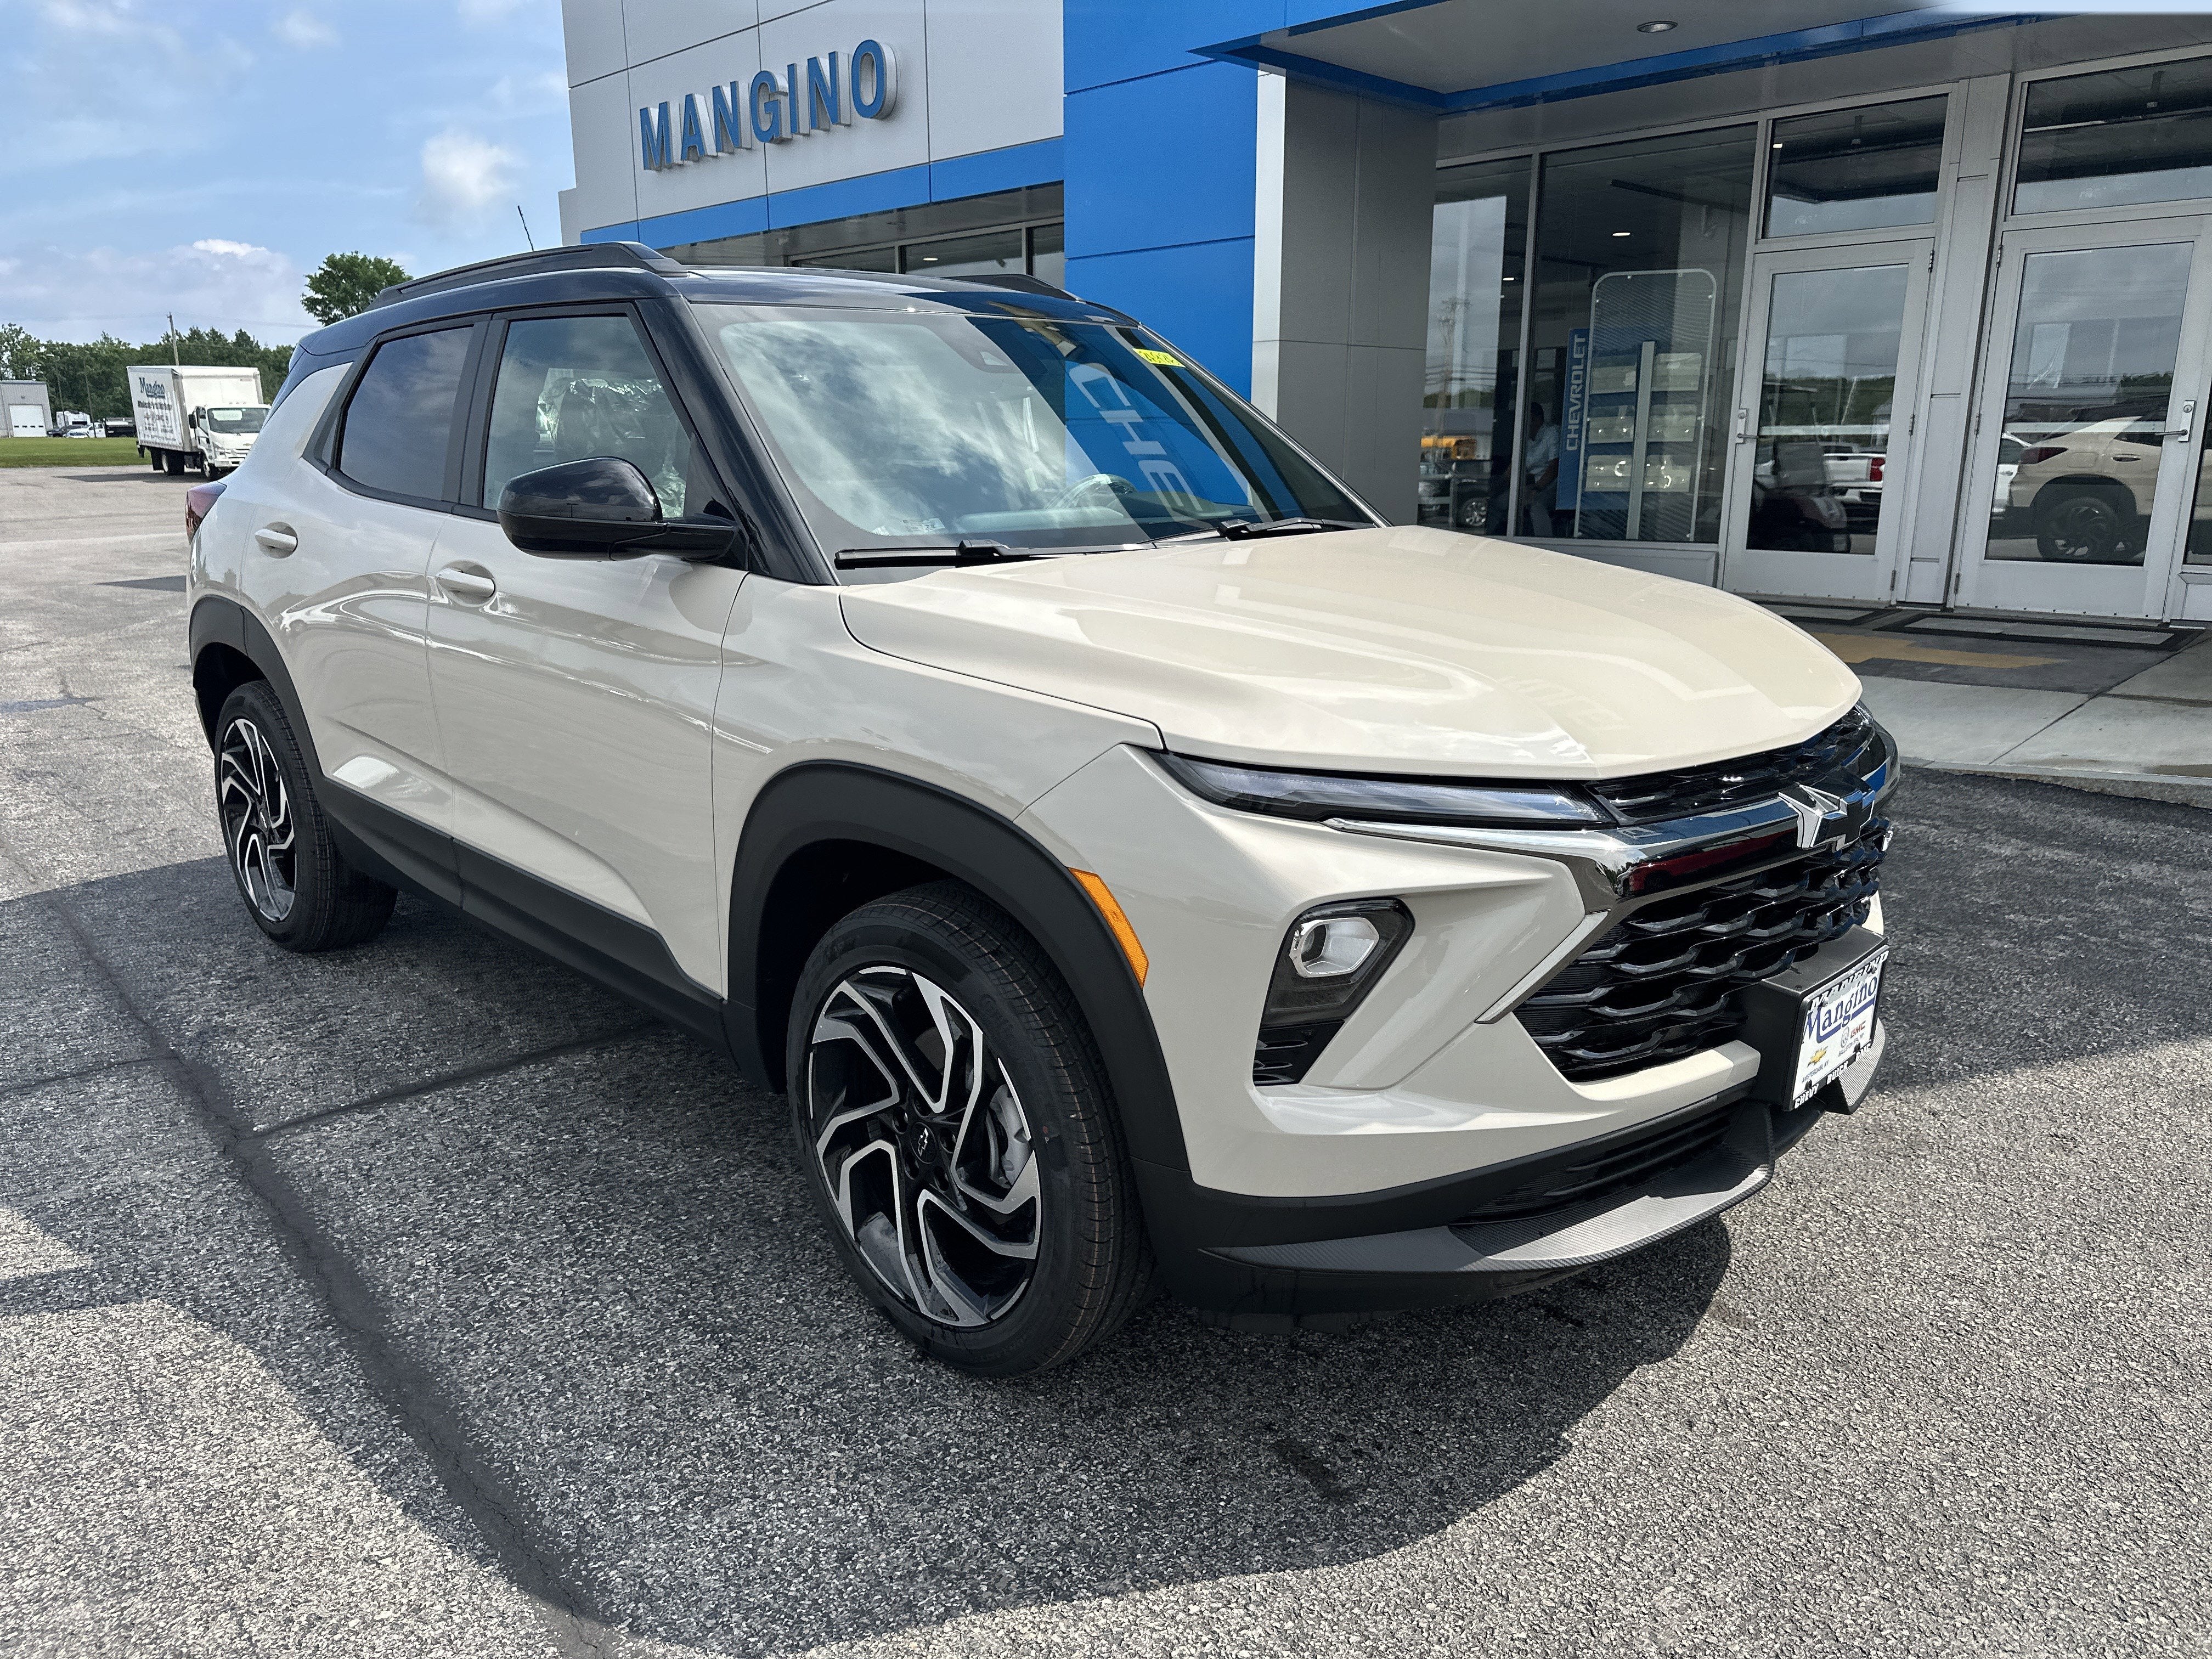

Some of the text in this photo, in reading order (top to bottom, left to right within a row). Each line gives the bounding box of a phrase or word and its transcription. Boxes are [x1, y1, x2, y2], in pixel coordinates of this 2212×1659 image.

[640, 40, 898, 171] MANGINO
[1566, 334, 1586, 451] CHEVROLET
[1803, 977, 1877, 1043] Mangino
[1850, 1020, 1866, 1039] GMC
[1794, 1043, 1871, 1109] CHEVY BUICK GMC
